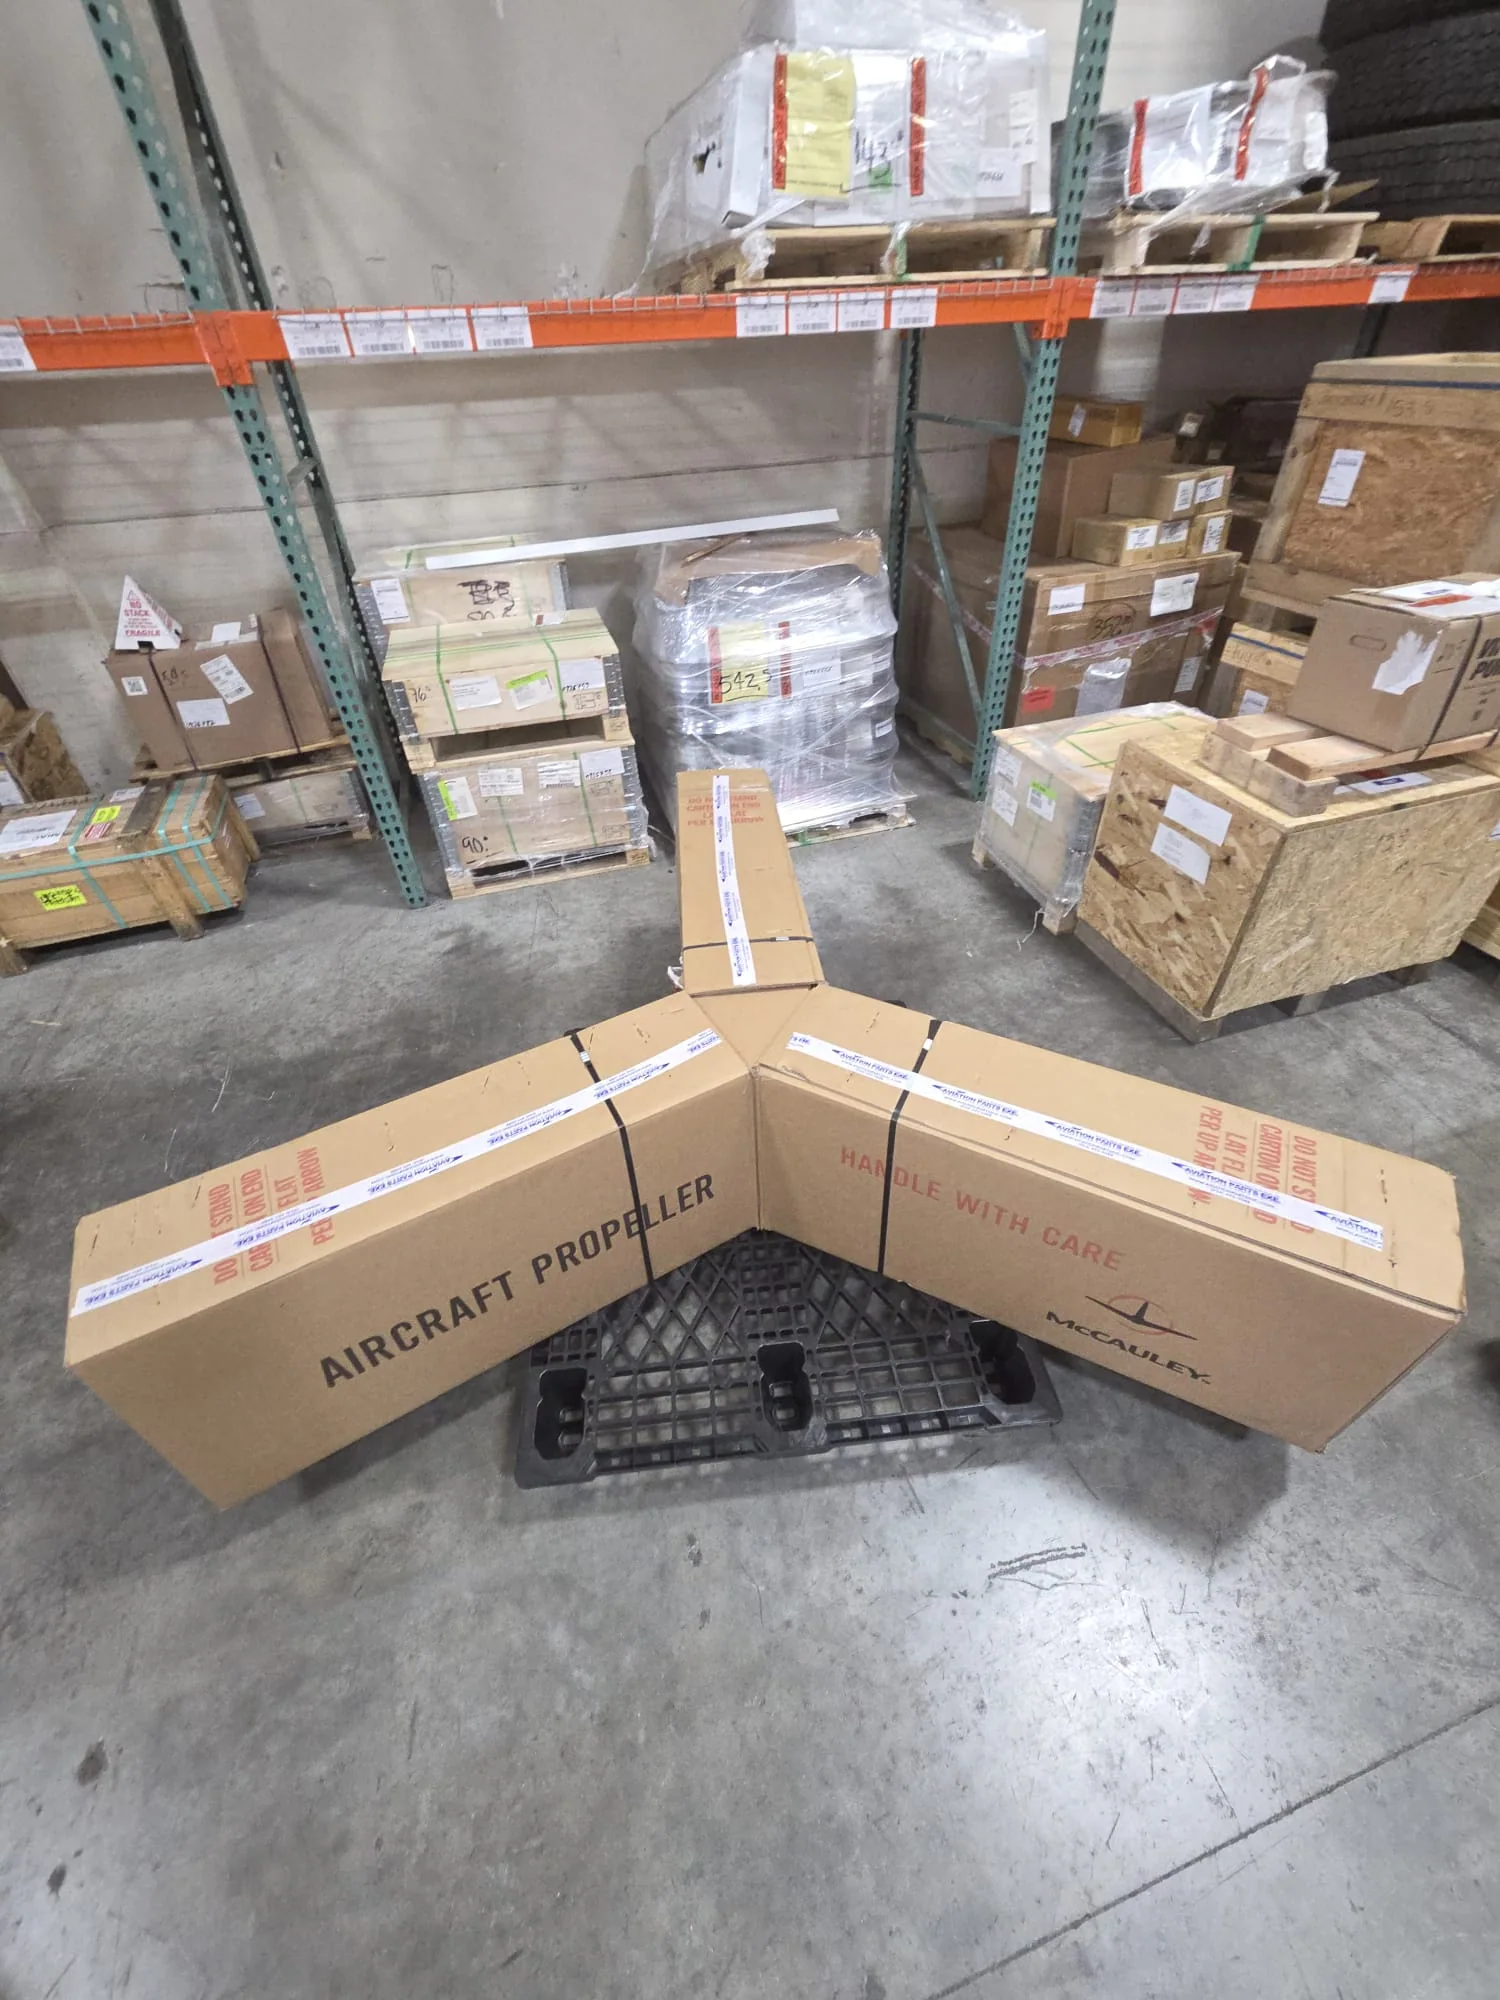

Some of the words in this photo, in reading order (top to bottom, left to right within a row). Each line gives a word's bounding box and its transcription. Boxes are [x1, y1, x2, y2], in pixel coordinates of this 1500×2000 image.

[1200, 1105, 1222, 1132] PER
[1056, 1124, 1094, 1142] AVIATION
[1197, 1131, 1220, 1151] UP
[1224, 1131, 1248, 1156] LAY
[1294, 1135, 1317, 1156] DO
[1257, 1123, 1283, 1172] CARTON
[241, 1168, 263, 1194] END
[296, 1147, 325, 1194] ARROW
[1184, 1166, 1227, 1186] AVIATION
[1292, 1156, 1317, 1187] NOT
[208, 1183, 234, 1228] STAND
[244, 1193, 266, 1216] ON
[274, 1175, 298, 1209] FLAT
[840, 1146, 942, 1201] HANDLE
[956, 1190, 1029, 1236] WITH
[1042, 1226, 1123, 1271] CARE
[212, 1258, 238, 1286] DO
[320, 1270, 514, 1389] AIRCRAFT
[531, 1173, 716, 1285] PROPELLER
